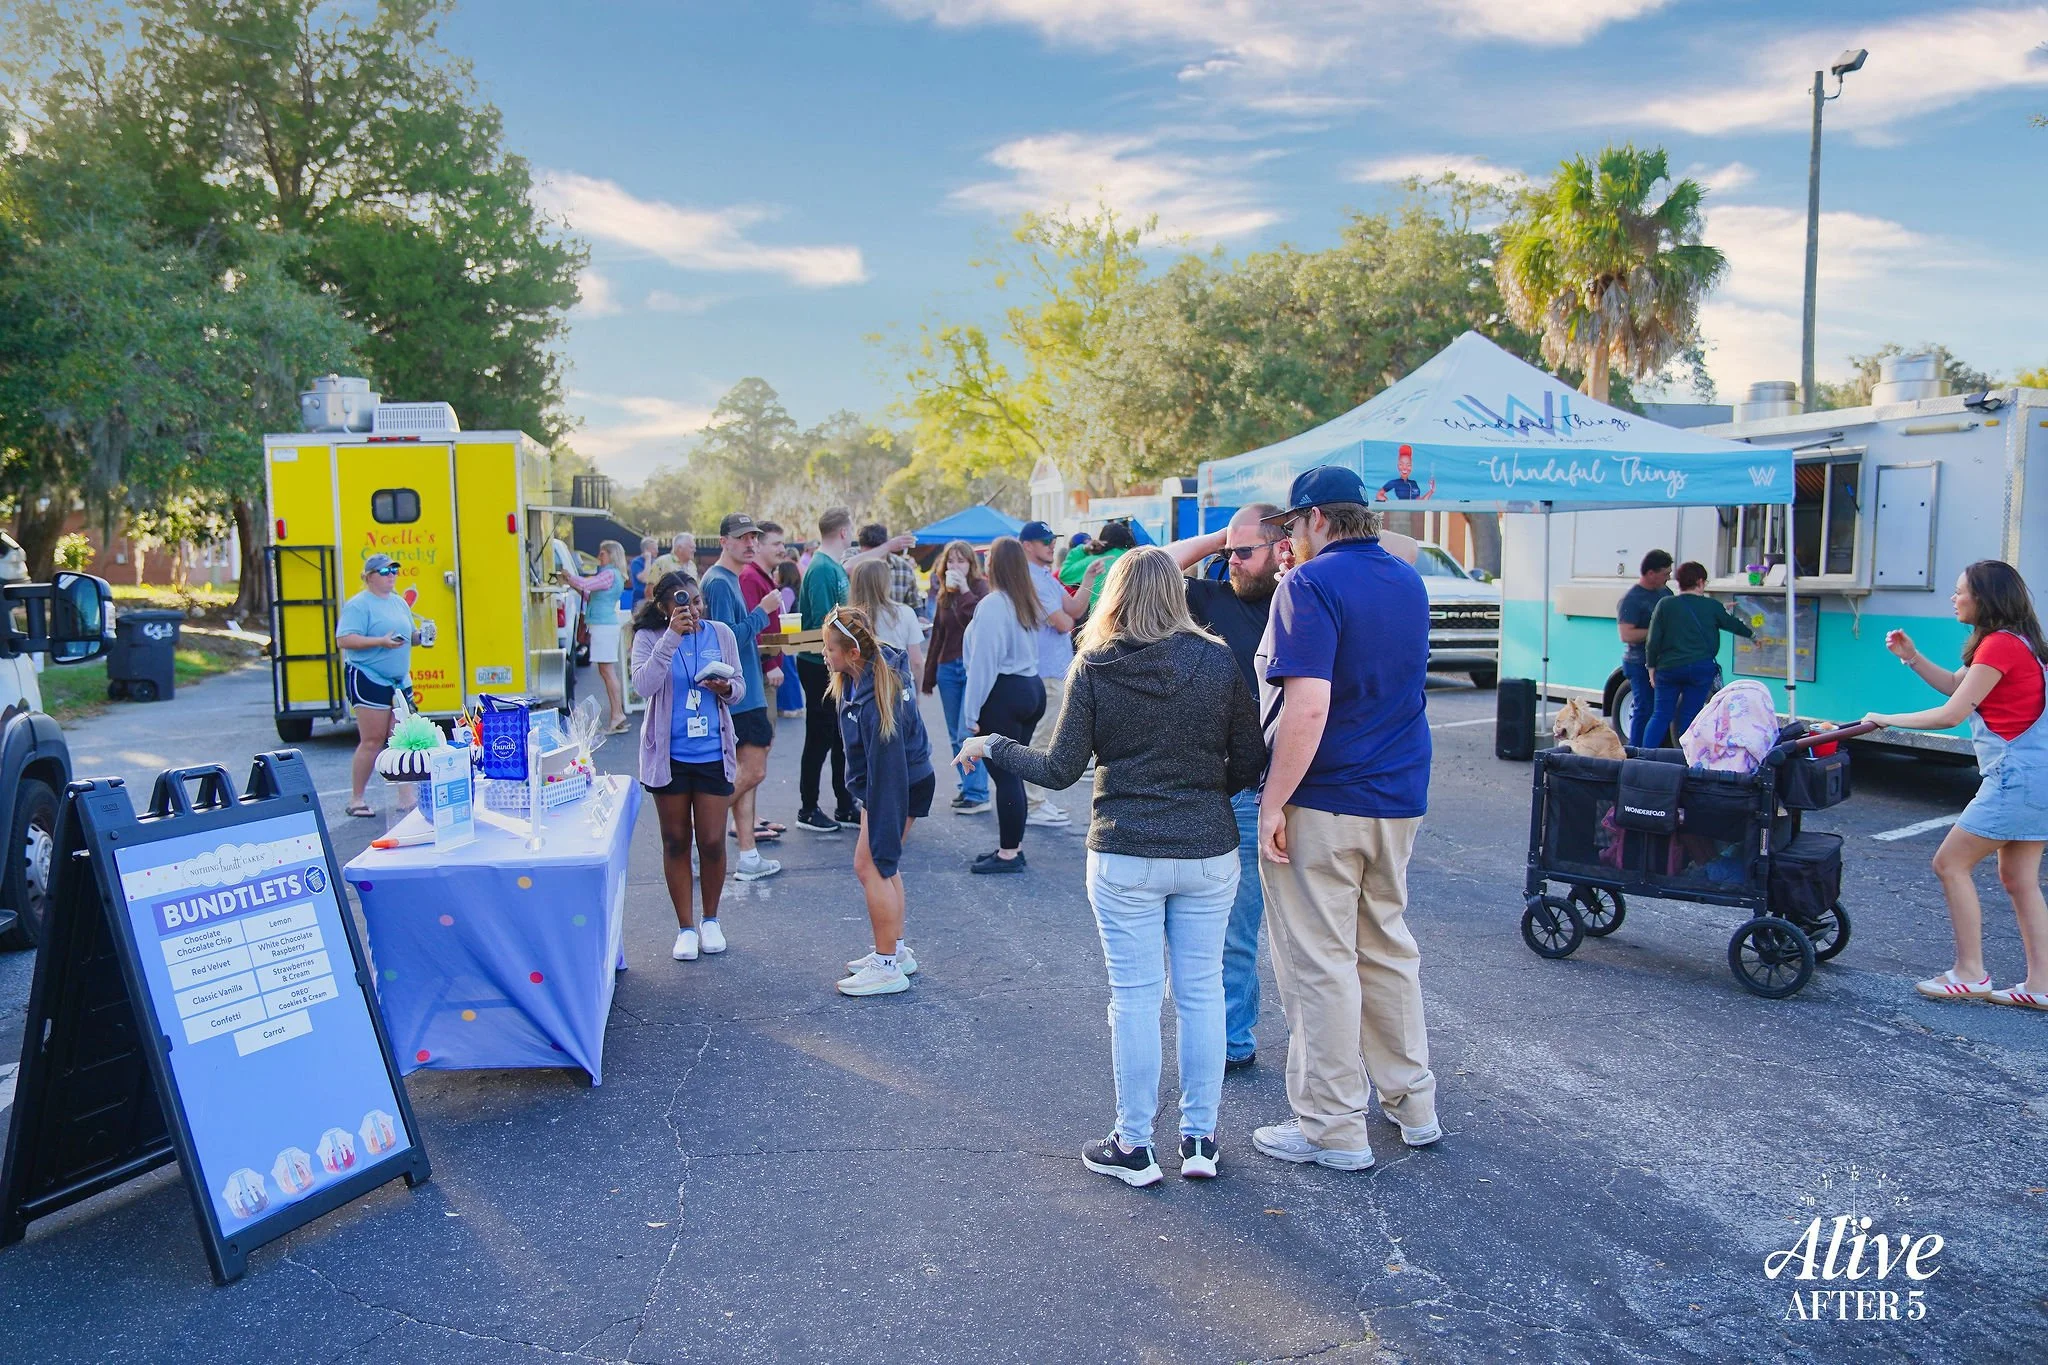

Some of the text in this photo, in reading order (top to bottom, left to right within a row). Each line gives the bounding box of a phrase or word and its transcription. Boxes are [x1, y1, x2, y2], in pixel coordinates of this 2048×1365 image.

[1432, 413, 1631, 432] Wandaful Things
[1478, 453, 1689, 499] Wandaful Things
[1748, 465, 1776, 487] W
[365, 529, 437, 548] Noelle's
[1448, 611, 1484, 619] RAM
[1624, 805, 1666, 817] WONDERFOLD
[190, 854, 265, 876] NOTHING bundt CAKES
[162, 874, 302, 929] BUNDTLETS
[269, 916, 292, 928] Lemon
[184, 929, 221, 945] Chocolate
[258, 931, 313, 952] White Chocolate
[177, 936, 233, 957] Chocolate Chip
[271, 943, 305, 958] Raspberry
[191, 960, 231, 977] Red Velvet
[272, 958, 315, 975] Strawberries
[282, 969, 311, 983] & Cream
[192, 984, 243, 1005] Classic Vanilla
[278, 991, 328, 1011] Cookies & Cream
[210, 1012, 242, 1028] Confetti
[263, 1026, 286, 1039] Carrot
